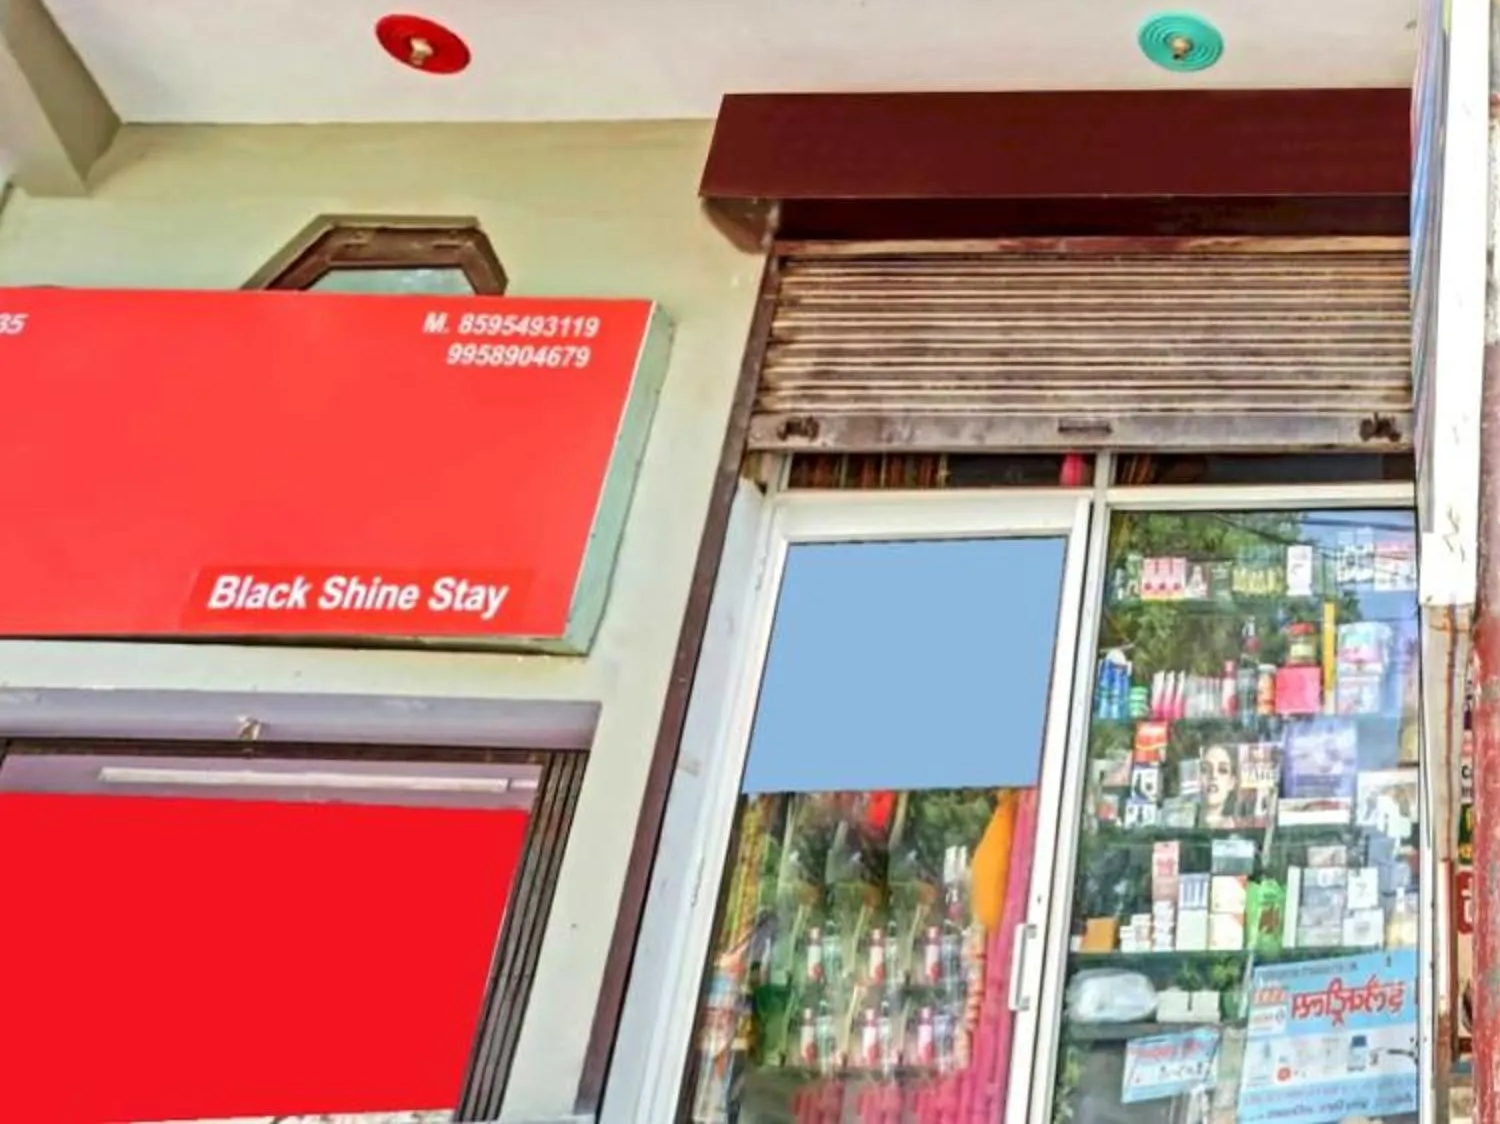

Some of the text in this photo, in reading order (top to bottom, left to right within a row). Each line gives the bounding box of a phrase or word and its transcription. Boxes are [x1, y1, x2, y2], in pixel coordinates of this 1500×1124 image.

[423, 312, 450, 334] M.
[446, 342, 592, 369] 9958904679
[207, 574, 509, 620] Black Shine Stay
